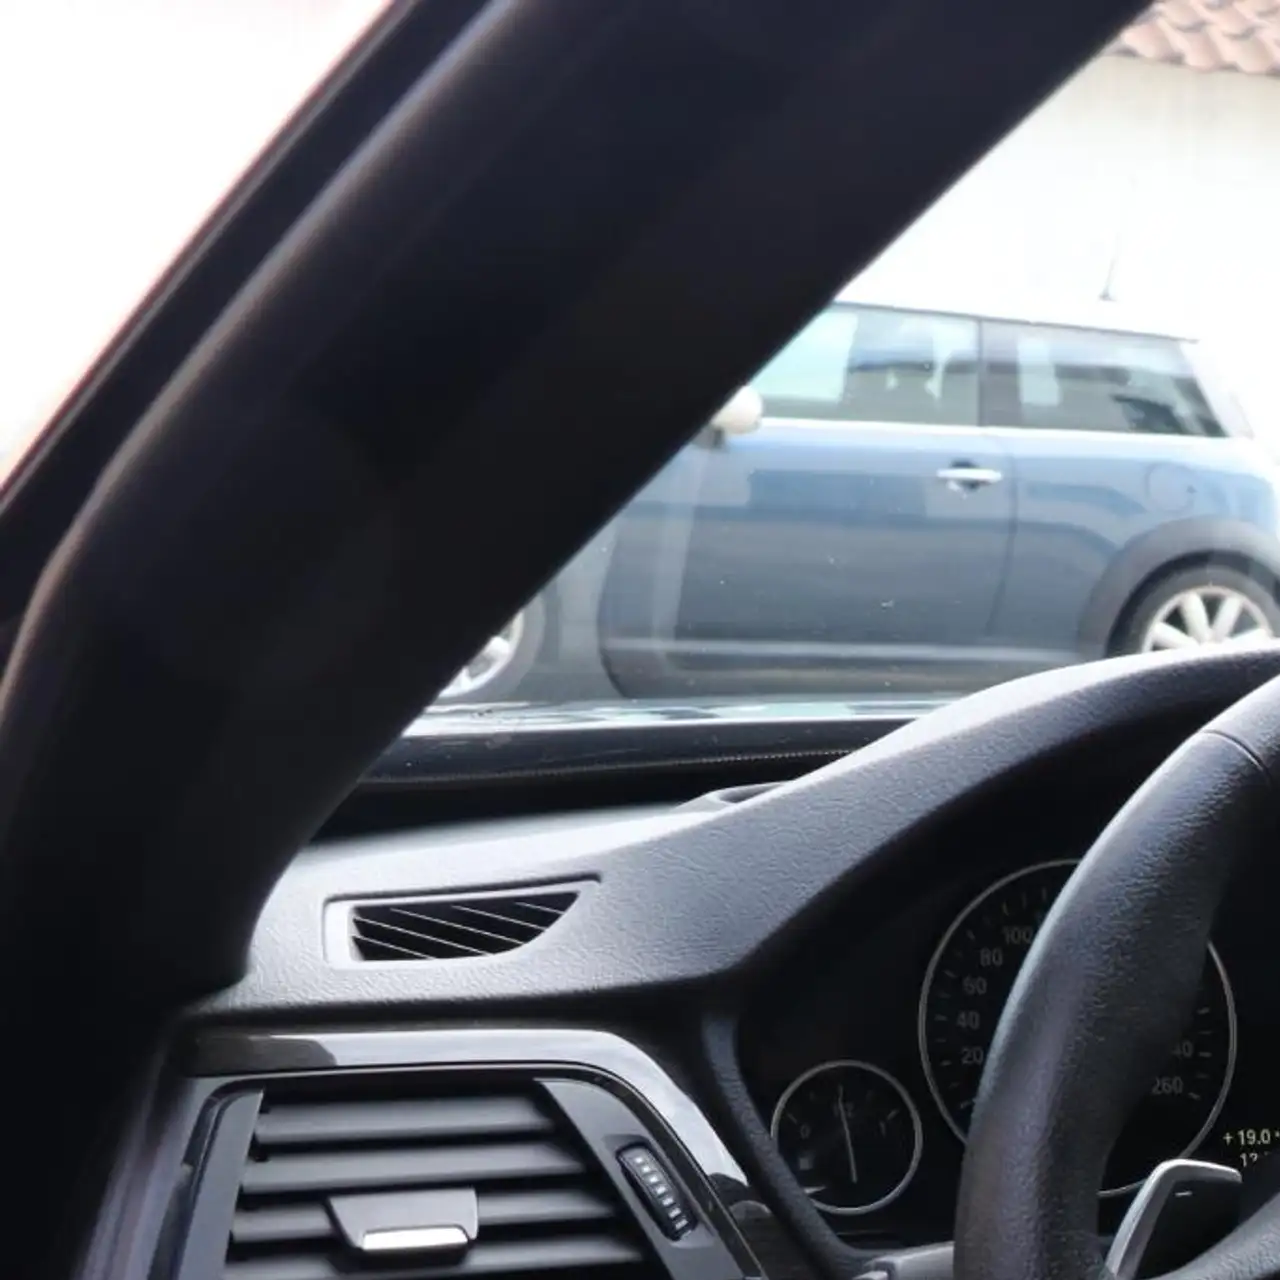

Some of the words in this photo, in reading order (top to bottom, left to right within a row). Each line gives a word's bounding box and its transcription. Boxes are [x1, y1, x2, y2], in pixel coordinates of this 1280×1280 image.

[1002, 926, 1034, 944] 100
[980, 947, 1003, 966] 80
[956, 1011, 980, 1030] 40
[961, 1047, 984, 1065] 20
